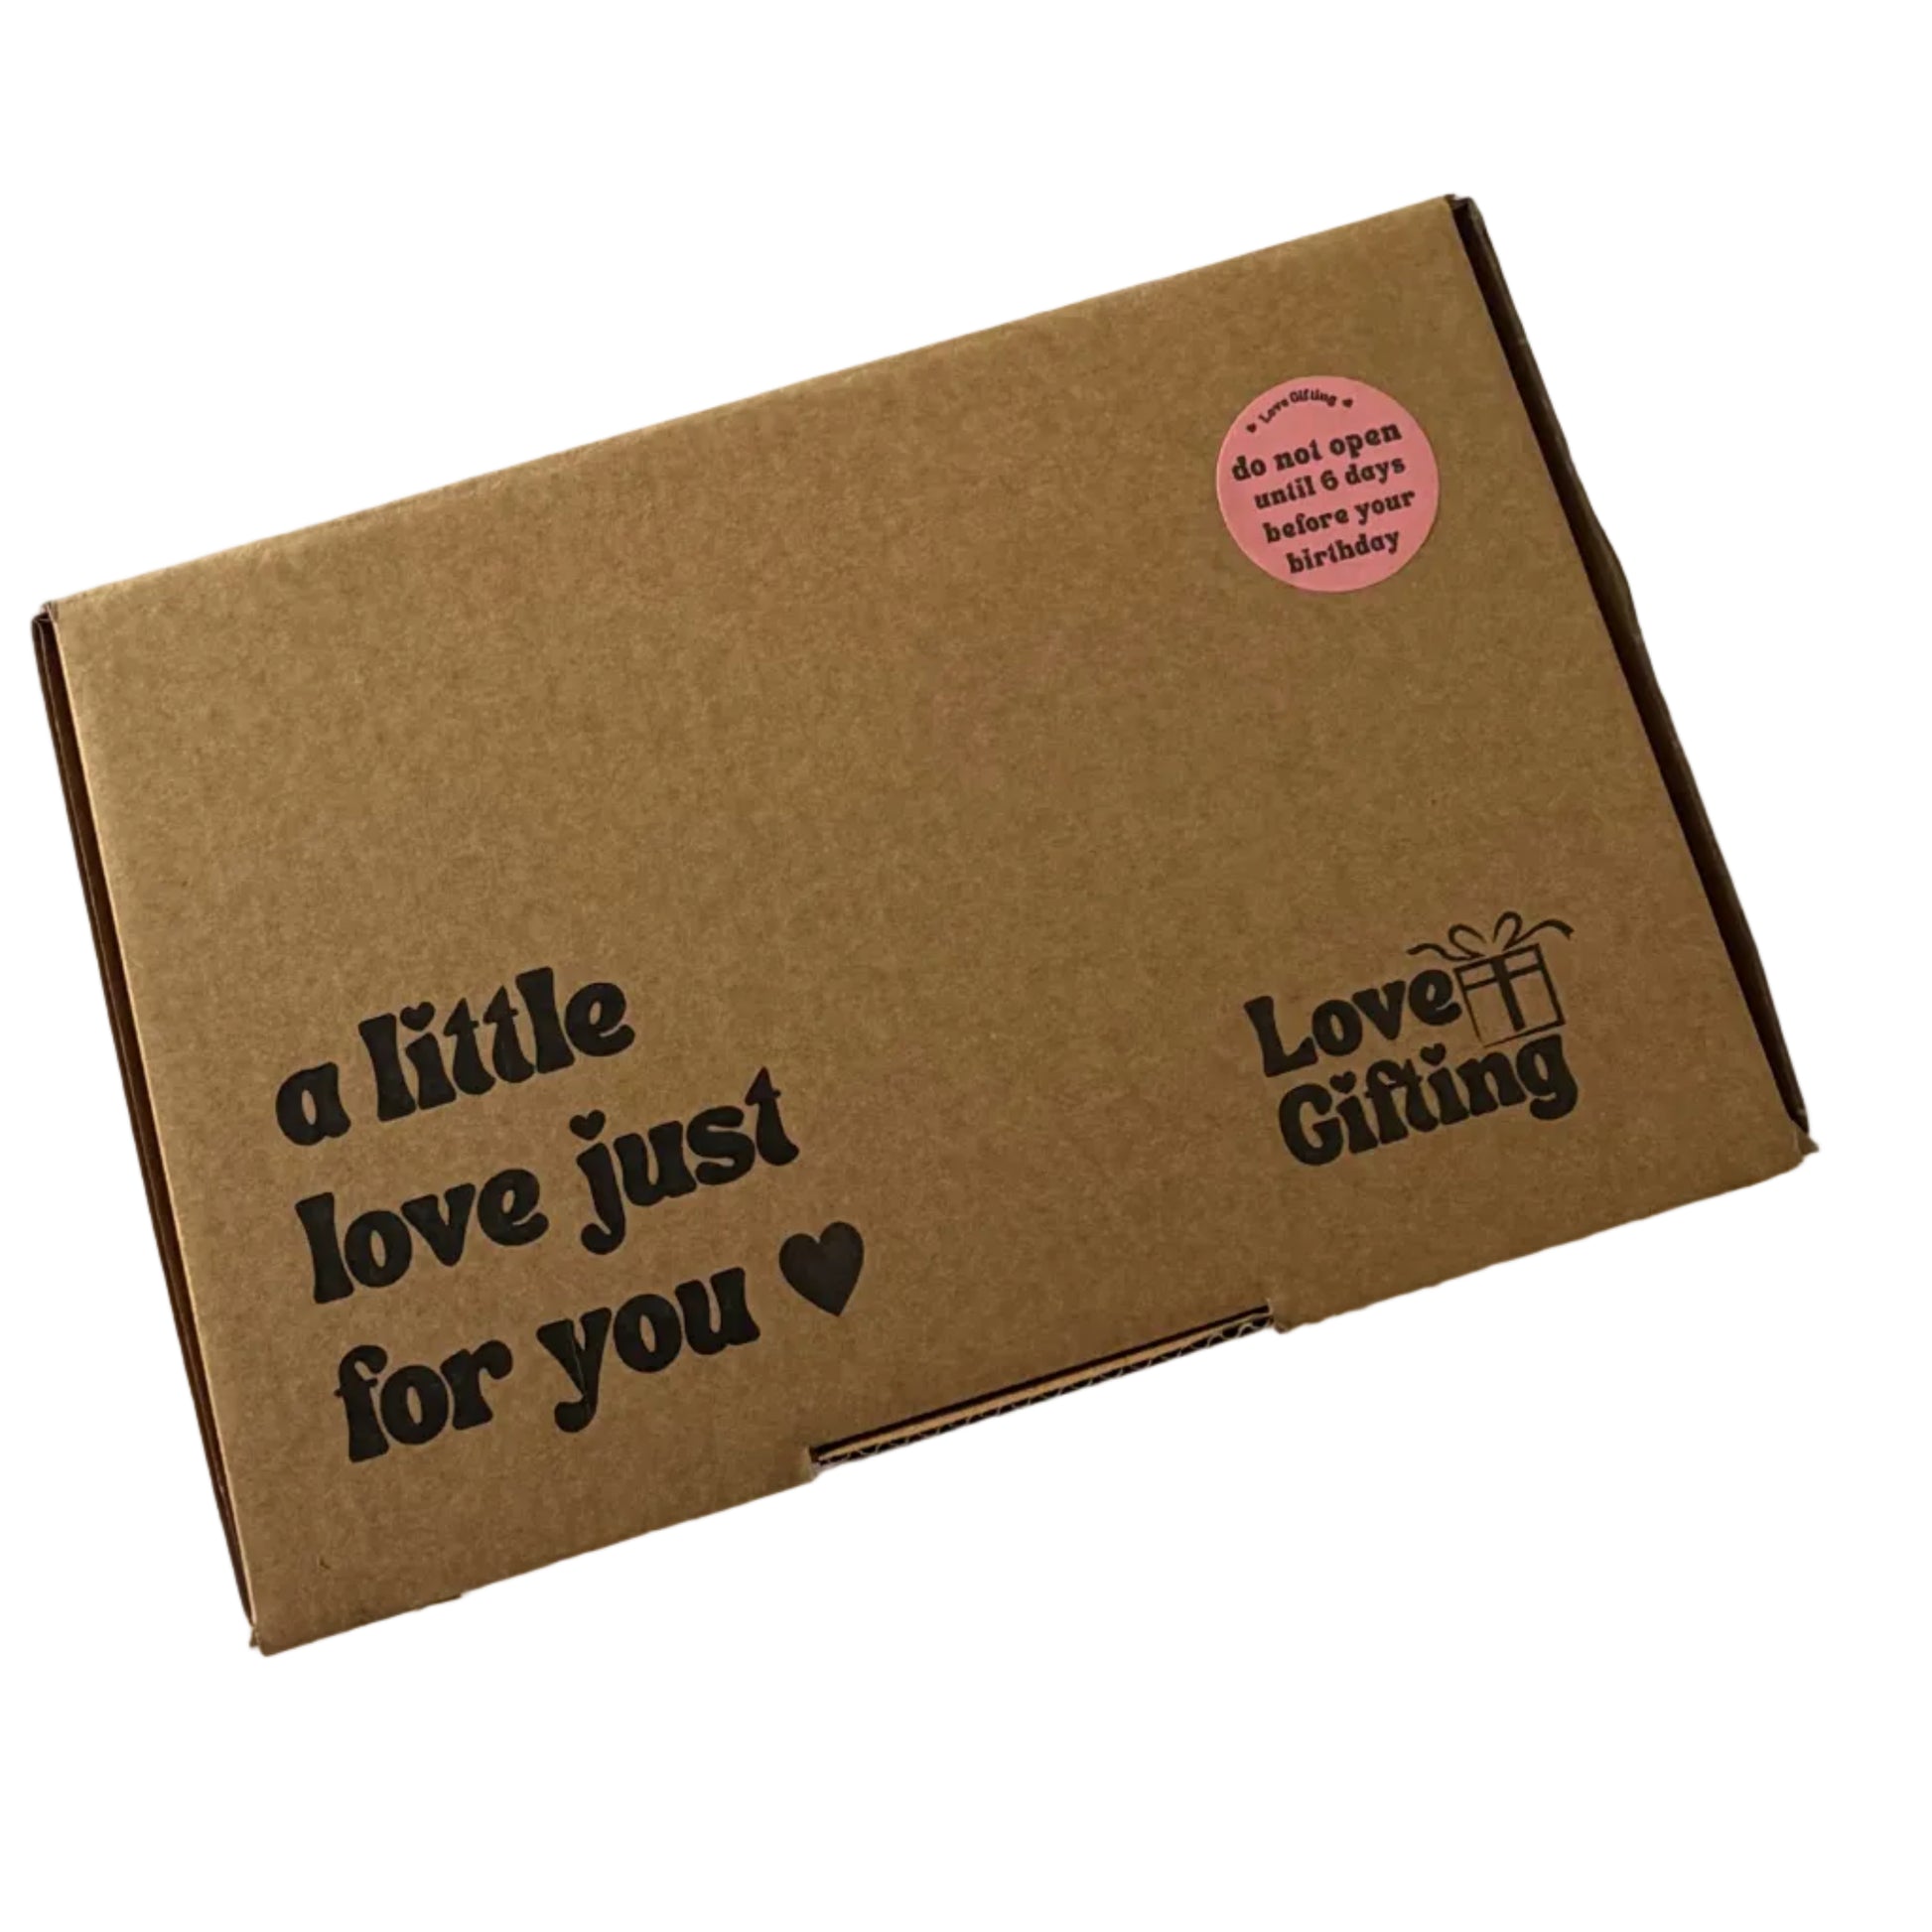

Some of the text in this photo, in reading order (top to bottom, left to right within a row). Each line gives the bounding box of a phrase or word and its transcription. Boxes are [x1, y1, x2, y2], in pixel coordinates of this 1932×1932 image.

[1259, 388, 1337, 424] Love Gifting
[1231, 423, 1403, 483] do not open
[1254, 458, 1407, 510] until 6 days
[1262, 489, 1417, 544] before your
[1285, 530, 1401, 575] birthday
[275, 966, 636, 1147] a little
[1242, 968, 1463, 1078] Love
[1277, 1033, 1579, 1168] Gifting
[294, 1065, 800, 1306] love just
[333, 1266, 761, 1464] for you
